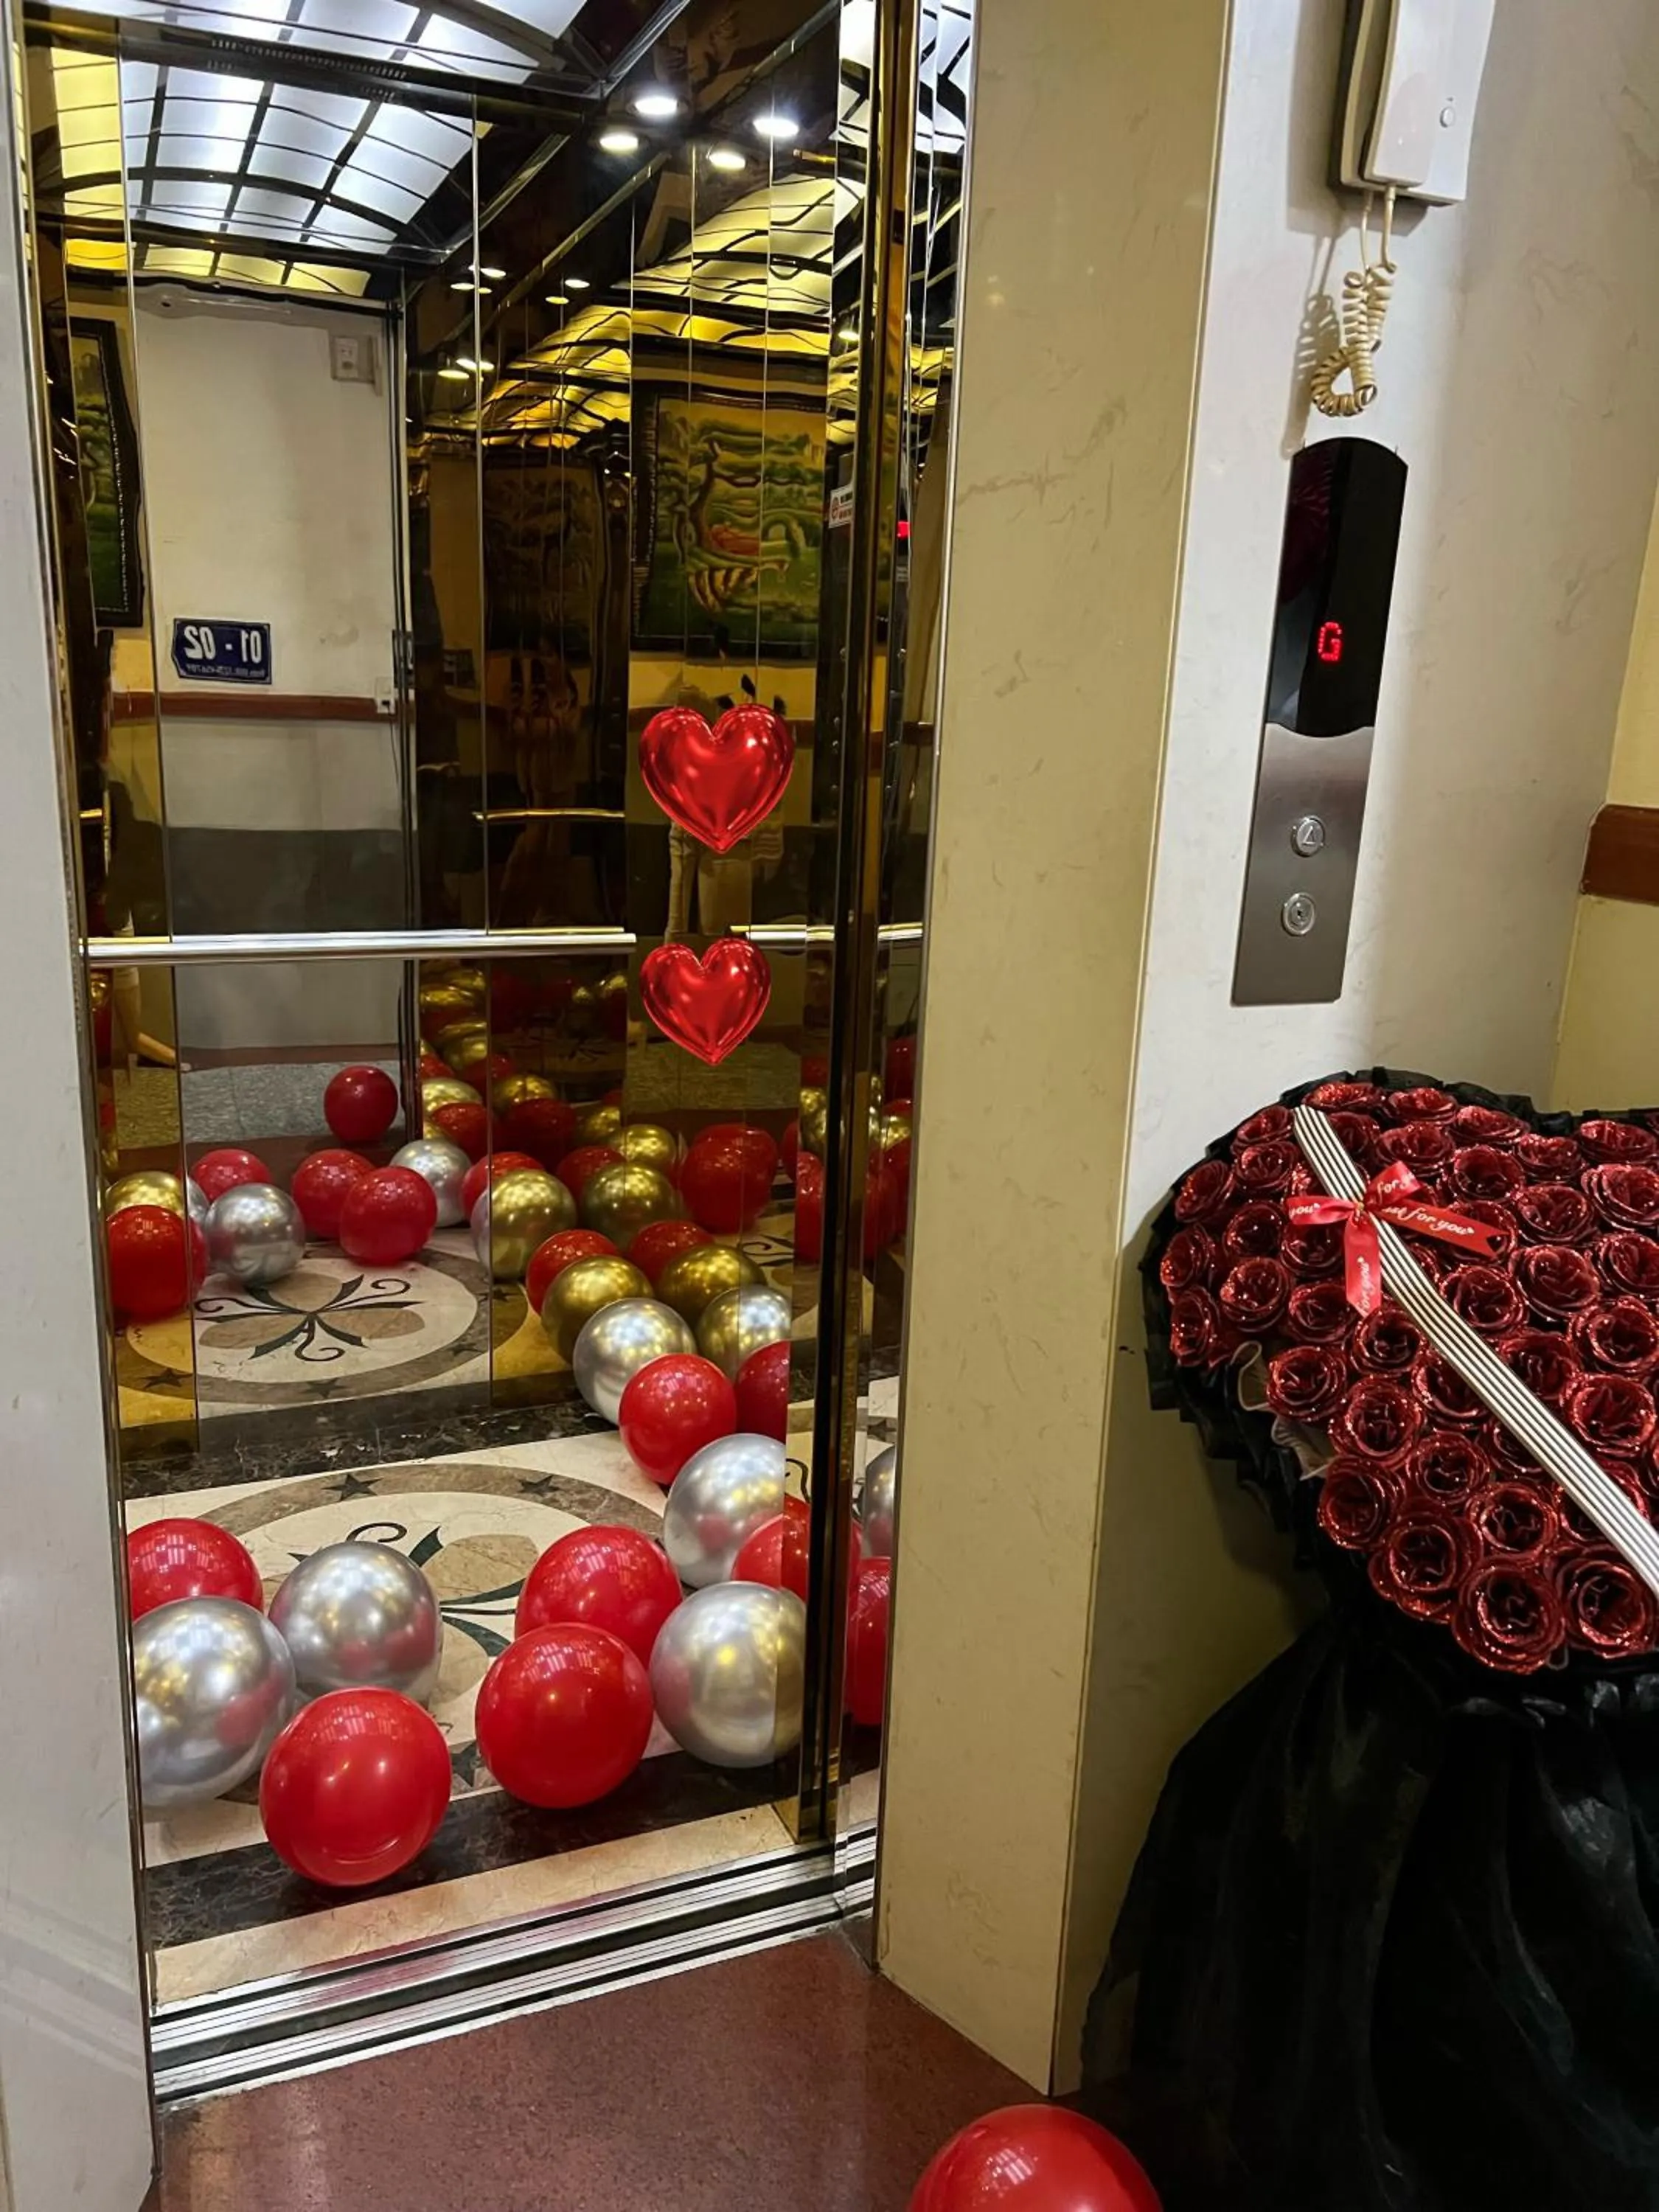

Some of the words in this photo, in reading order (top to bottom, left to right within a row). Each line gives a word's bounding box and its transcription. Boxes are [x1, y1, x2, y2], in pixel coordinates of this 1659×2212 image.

[1318, 622, 1342, 661] G
[1399, 1208, 1436, 1221] for
[1429, 1220, 1468, 1236] you
